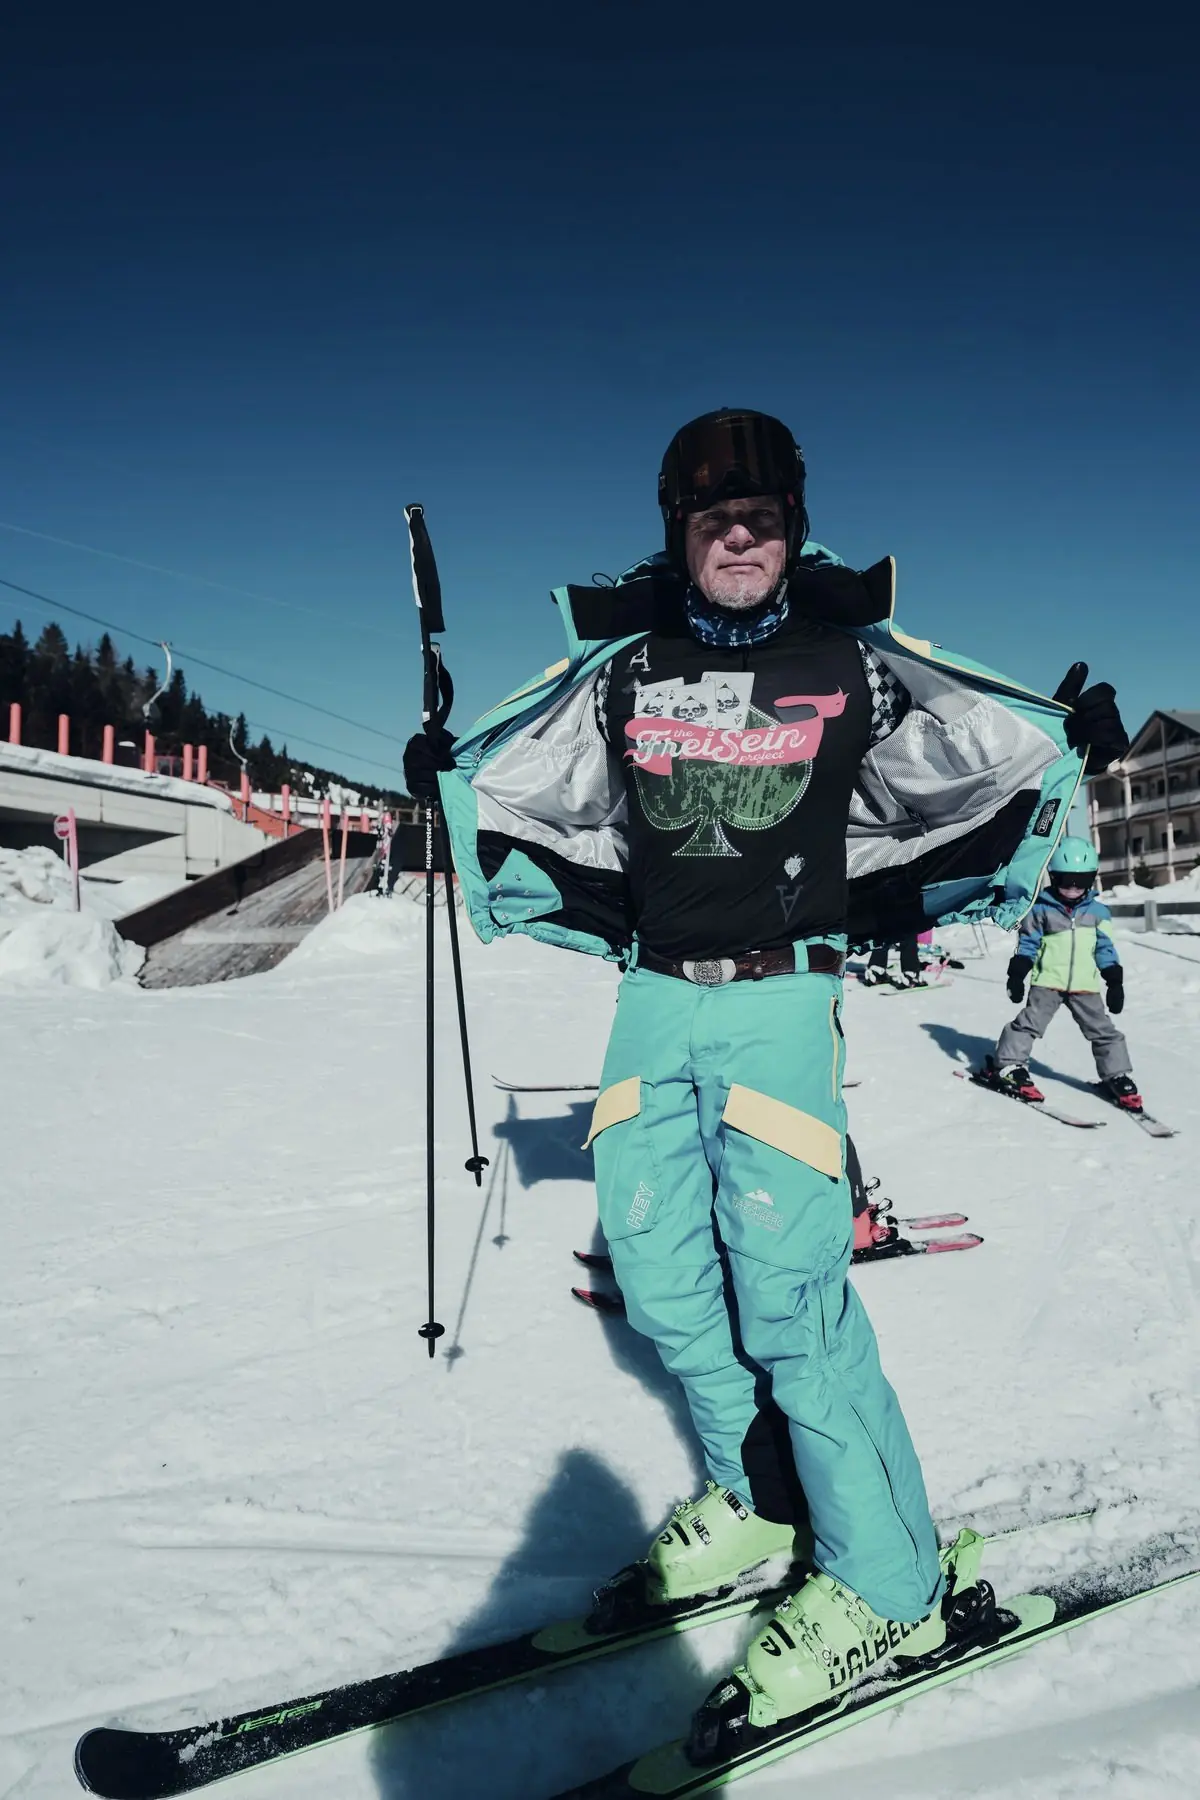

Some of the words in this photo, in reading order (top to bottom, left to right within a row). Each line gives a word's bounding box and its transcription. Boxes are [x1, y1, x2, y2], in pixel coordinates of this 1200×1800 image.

[629, 643, 651, 672] A
[633, 725, 807, 764] FreiSein
[673, 729, 695, 738] the
[738, 749, 785, 765] project
[626, 1181, 656, 1229] HEY
